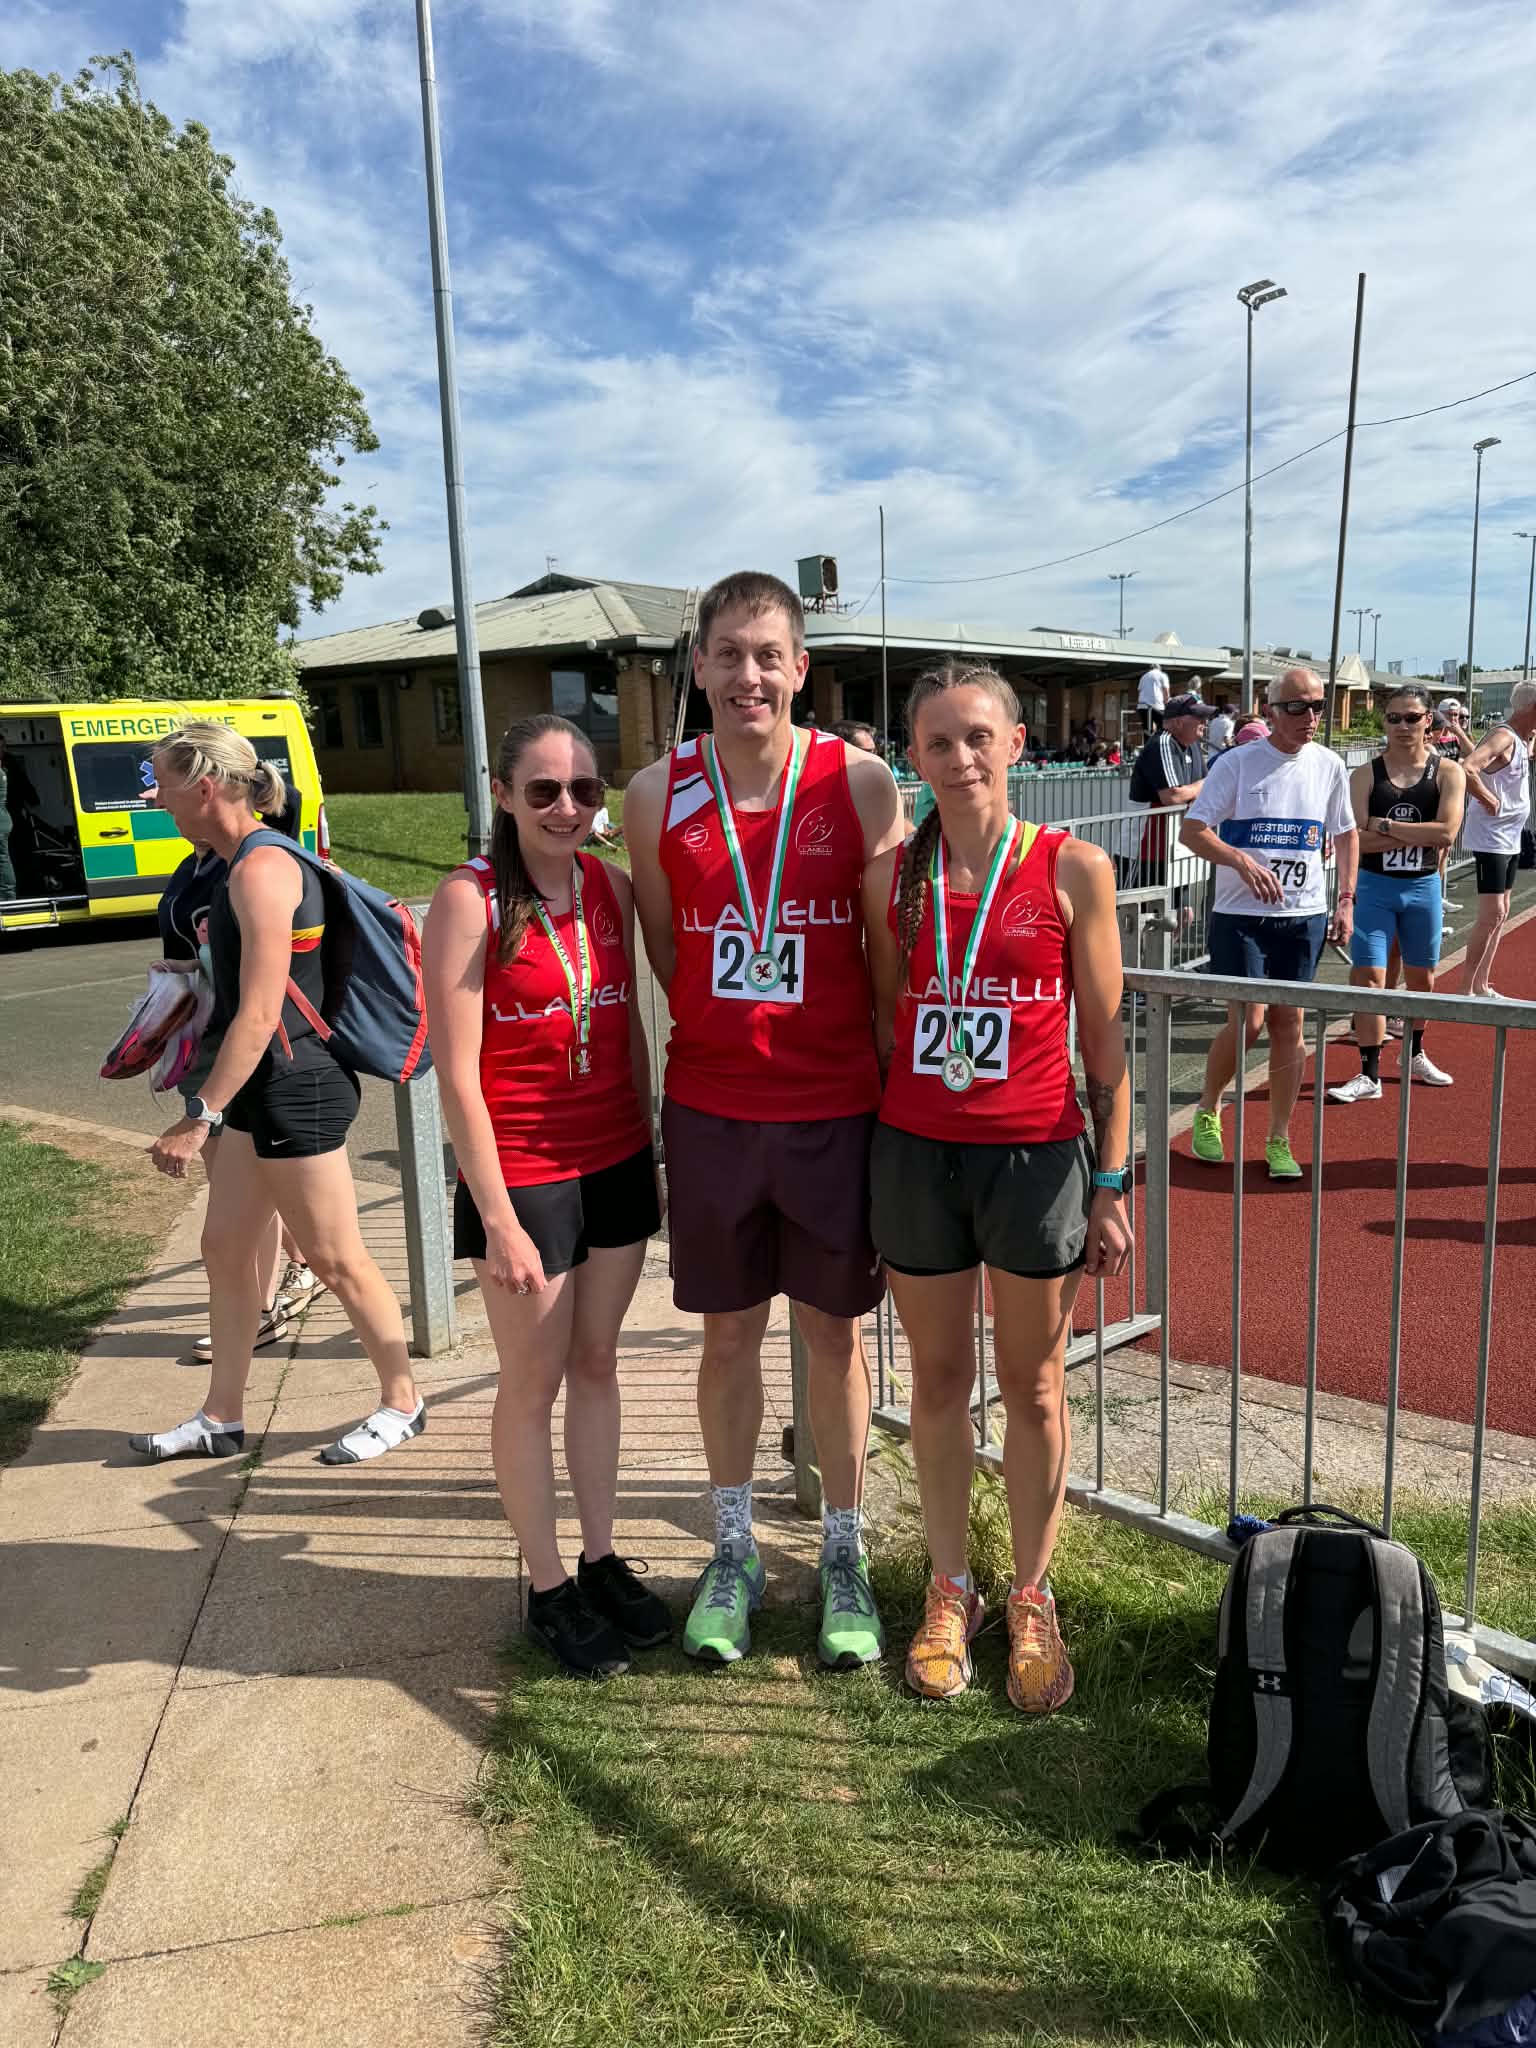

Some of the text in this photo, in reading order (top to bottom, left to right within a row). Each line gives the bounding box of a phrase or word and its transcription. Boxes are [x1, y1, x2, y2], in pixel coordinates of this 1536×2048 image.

[1394, 807, 1414, 817] CDF
[1250, 834, 1299, 845] HARRIERS
[1251, 823, 1303, 834] WESTBURY
[1386, 847, 1419, 868] 214
[1270, 859, 1307, 888] 379
[681, 898, 853, 933] LLAELLI
[551, 930, 570, 965] WMAA
[578, 937, 588, 969] WMAA
[717, 935, 799, 994] 24
[905, 975, 1062, 1002] LANELLI
[580, 988, 589, 1022] WMAA
[920, 1009, 1002, 1069] 252
